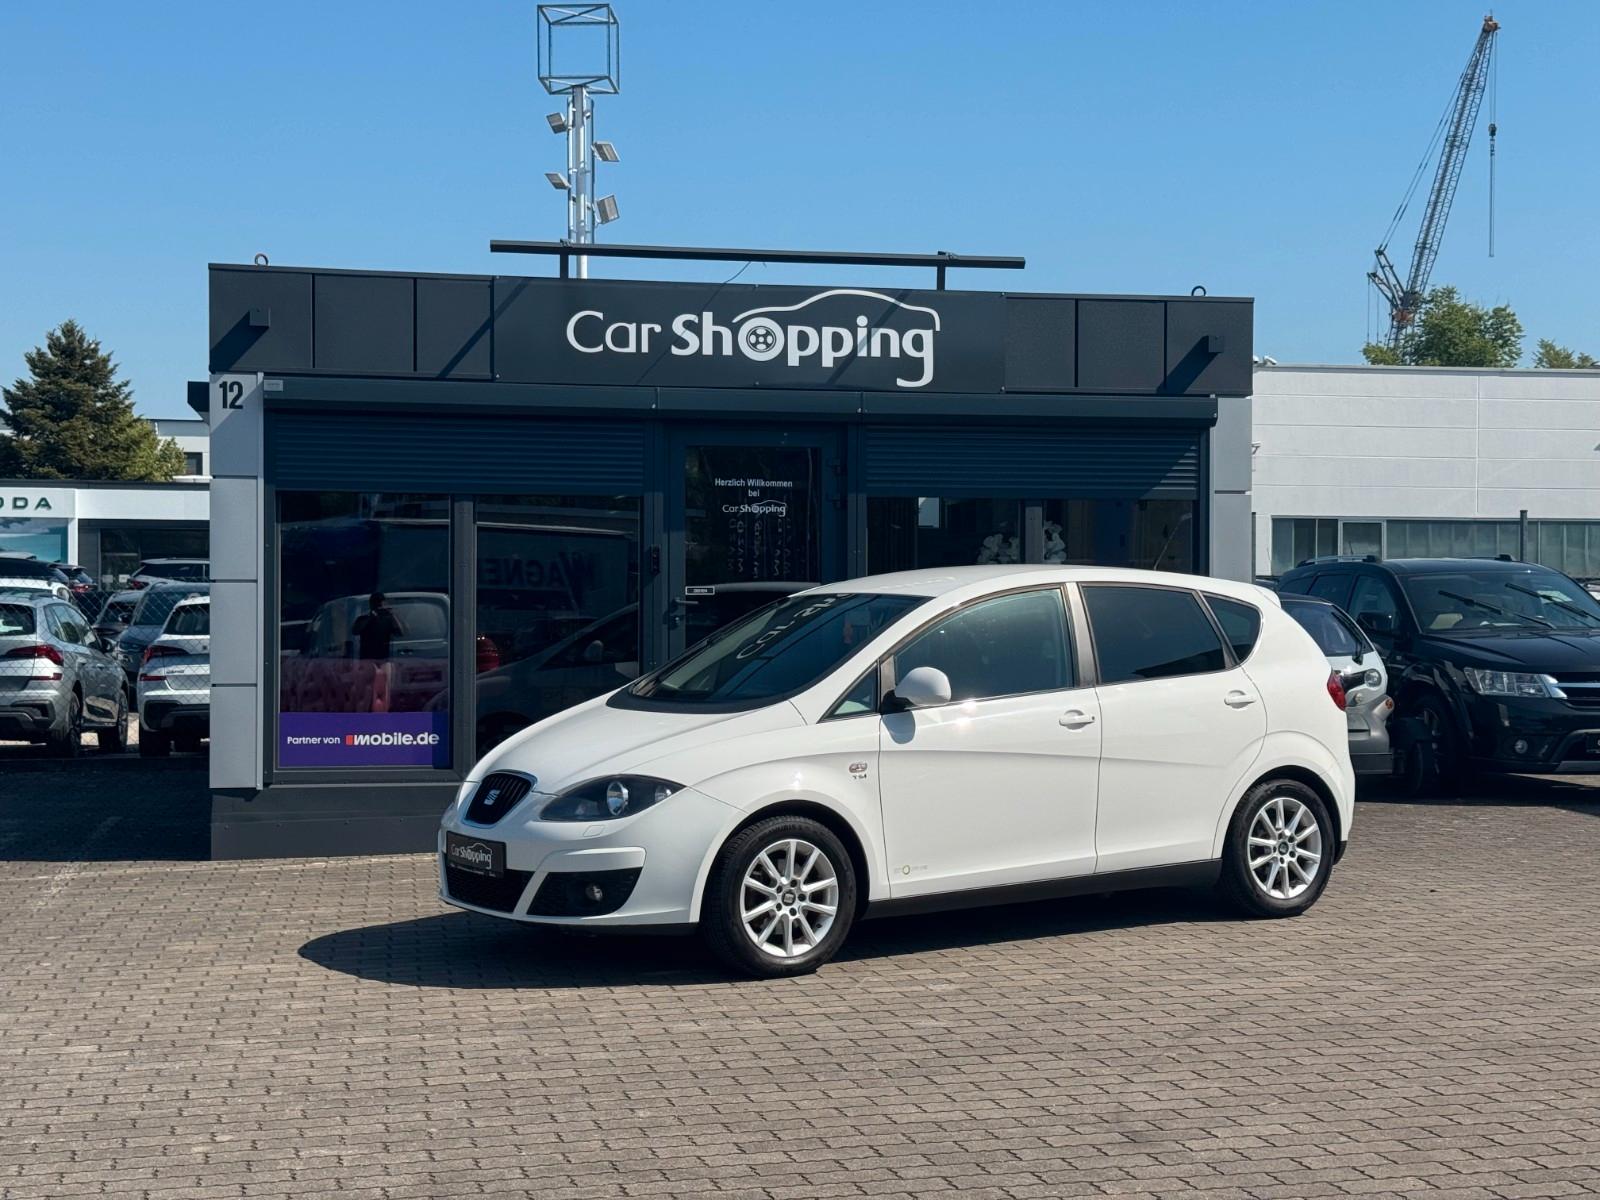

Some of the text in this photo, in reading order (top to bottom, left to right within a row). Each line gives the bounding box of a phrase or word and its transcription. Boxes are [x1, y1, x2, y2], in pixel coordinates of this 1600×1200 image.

[566, 310, 940, 388] Car Shopping
[219, 380, 244, 410] 12
[714, 478, 793, 488] Herzlich Willkommen
[748, 489, 760, 498] bei
[722, 502, 787, 517] Car Shopping
[287, 732, 440, 746] Partner von mobile.de
